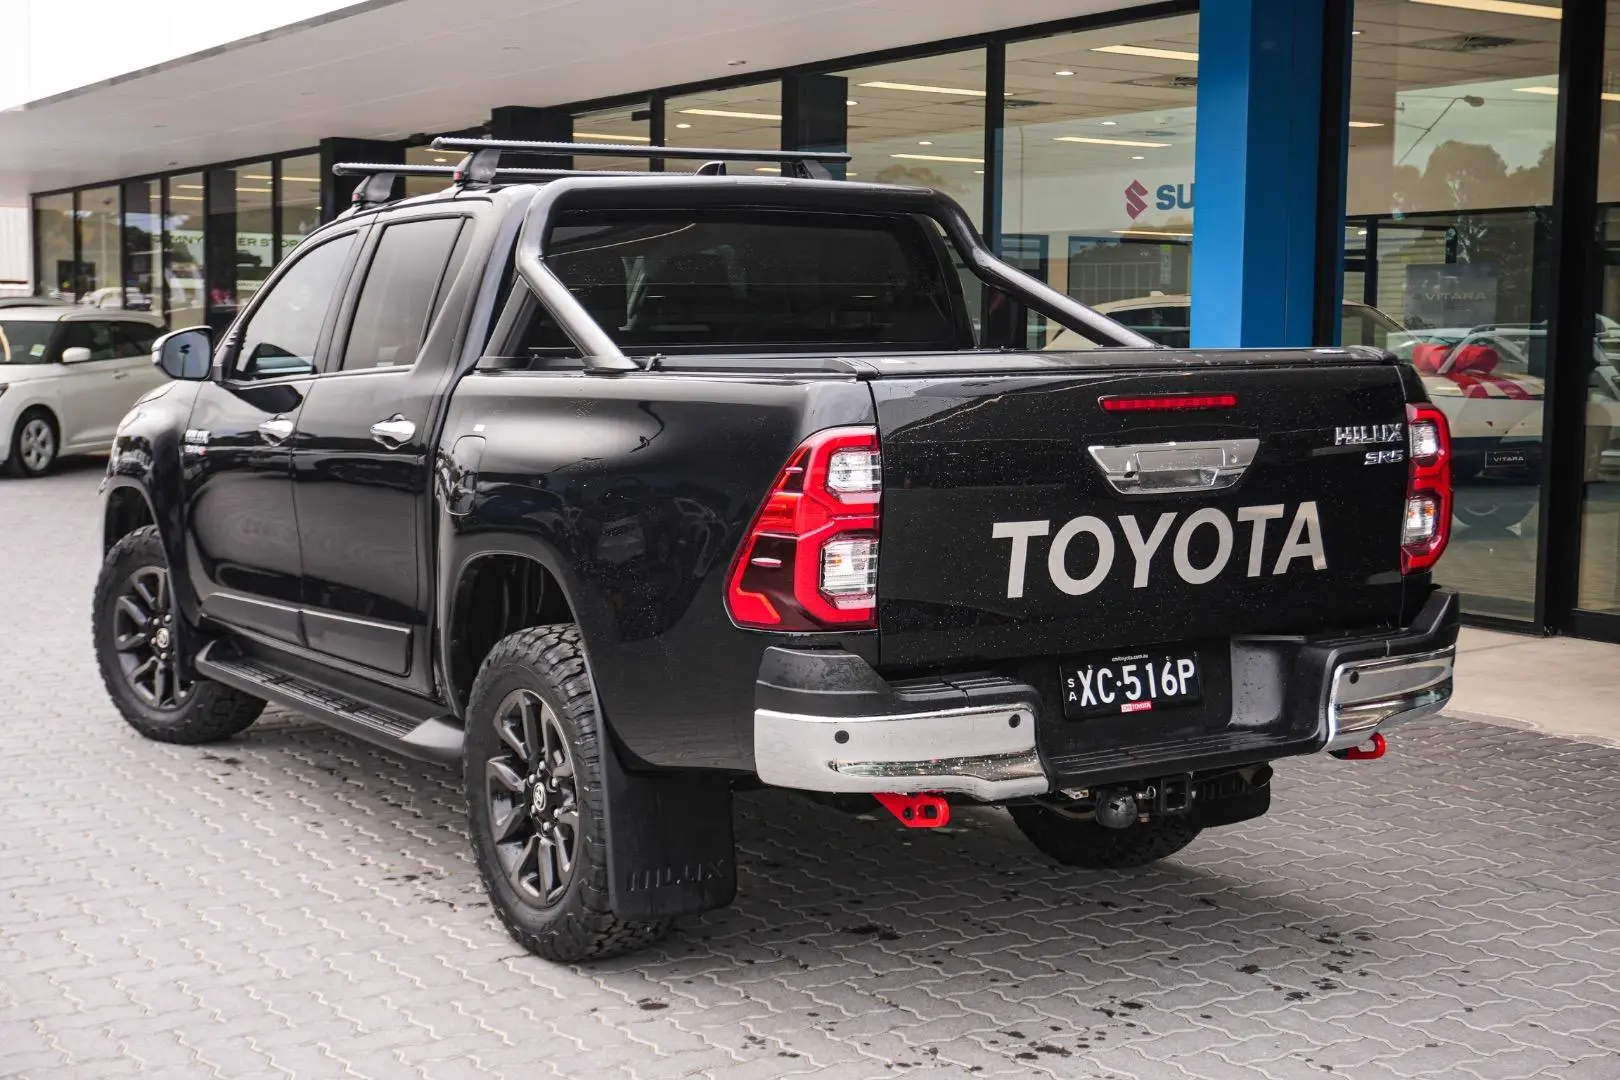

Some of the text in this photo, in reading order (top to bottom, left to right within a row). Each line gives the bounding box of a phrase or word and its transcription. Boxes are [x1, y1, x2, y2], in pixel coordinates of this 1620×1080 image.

[1424, 291, 1488, 301] VITARA
[1334, 422, 1404, 446] HILUX
[1363, 449, 1405, 466] SR5
[1493, 455, 1525, 463] VITARA
[992, 501, 1328, 599] TOYOTA
[1132, 702, 1152, 711] TOYOTA
[625, 859, 724, 892] HILUX
